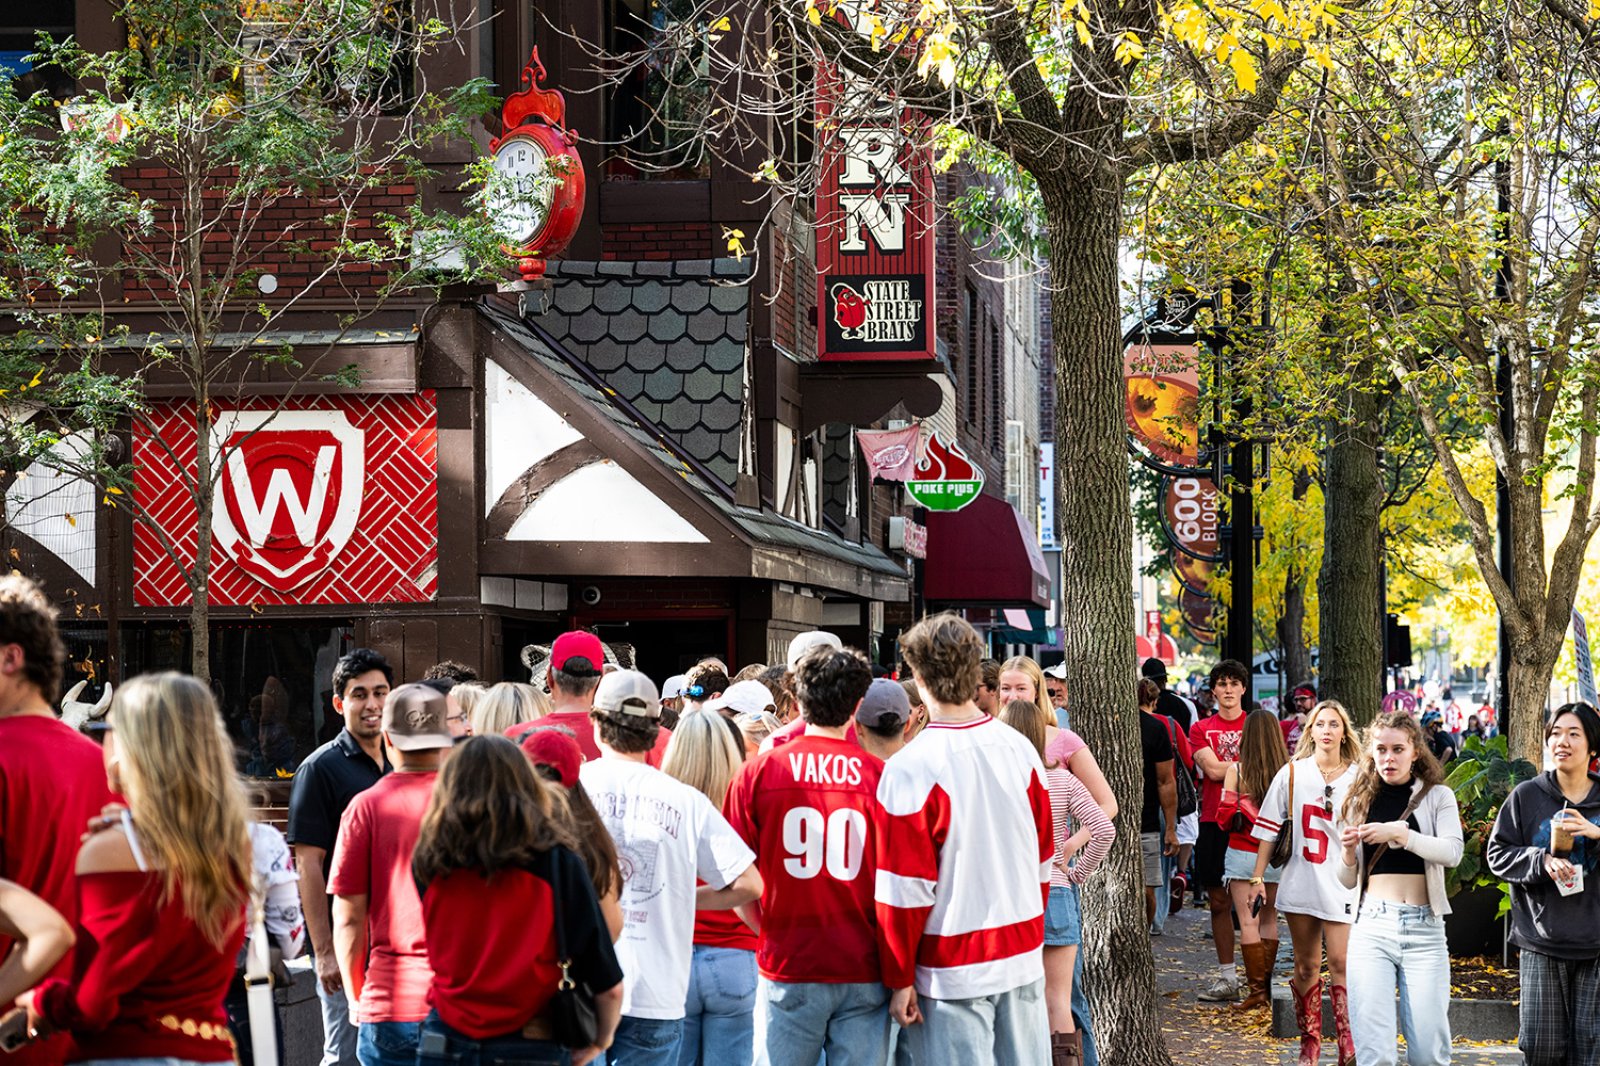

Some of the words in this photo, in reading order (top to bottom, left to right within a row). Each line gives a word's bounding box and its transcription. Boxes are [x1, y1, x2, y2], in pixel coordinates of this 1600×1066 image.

[865, 281, 909, 301] STATE
[866, 301, 921, 321] STREET
[866, 320, 915, 340] BRATS
[225, 445, 337, 550] W
[914, 483, 944, 494] POKE
[947, 483, 974, 497] PLUS
[1174, 478, 1201, 543] 600
[1202, 489, 1217, 542] BLOCK
[788, 752, 862, 786] VAKOS
[782, 806, 868, 882] 90
[1302, 803, 1334, 865] 5
